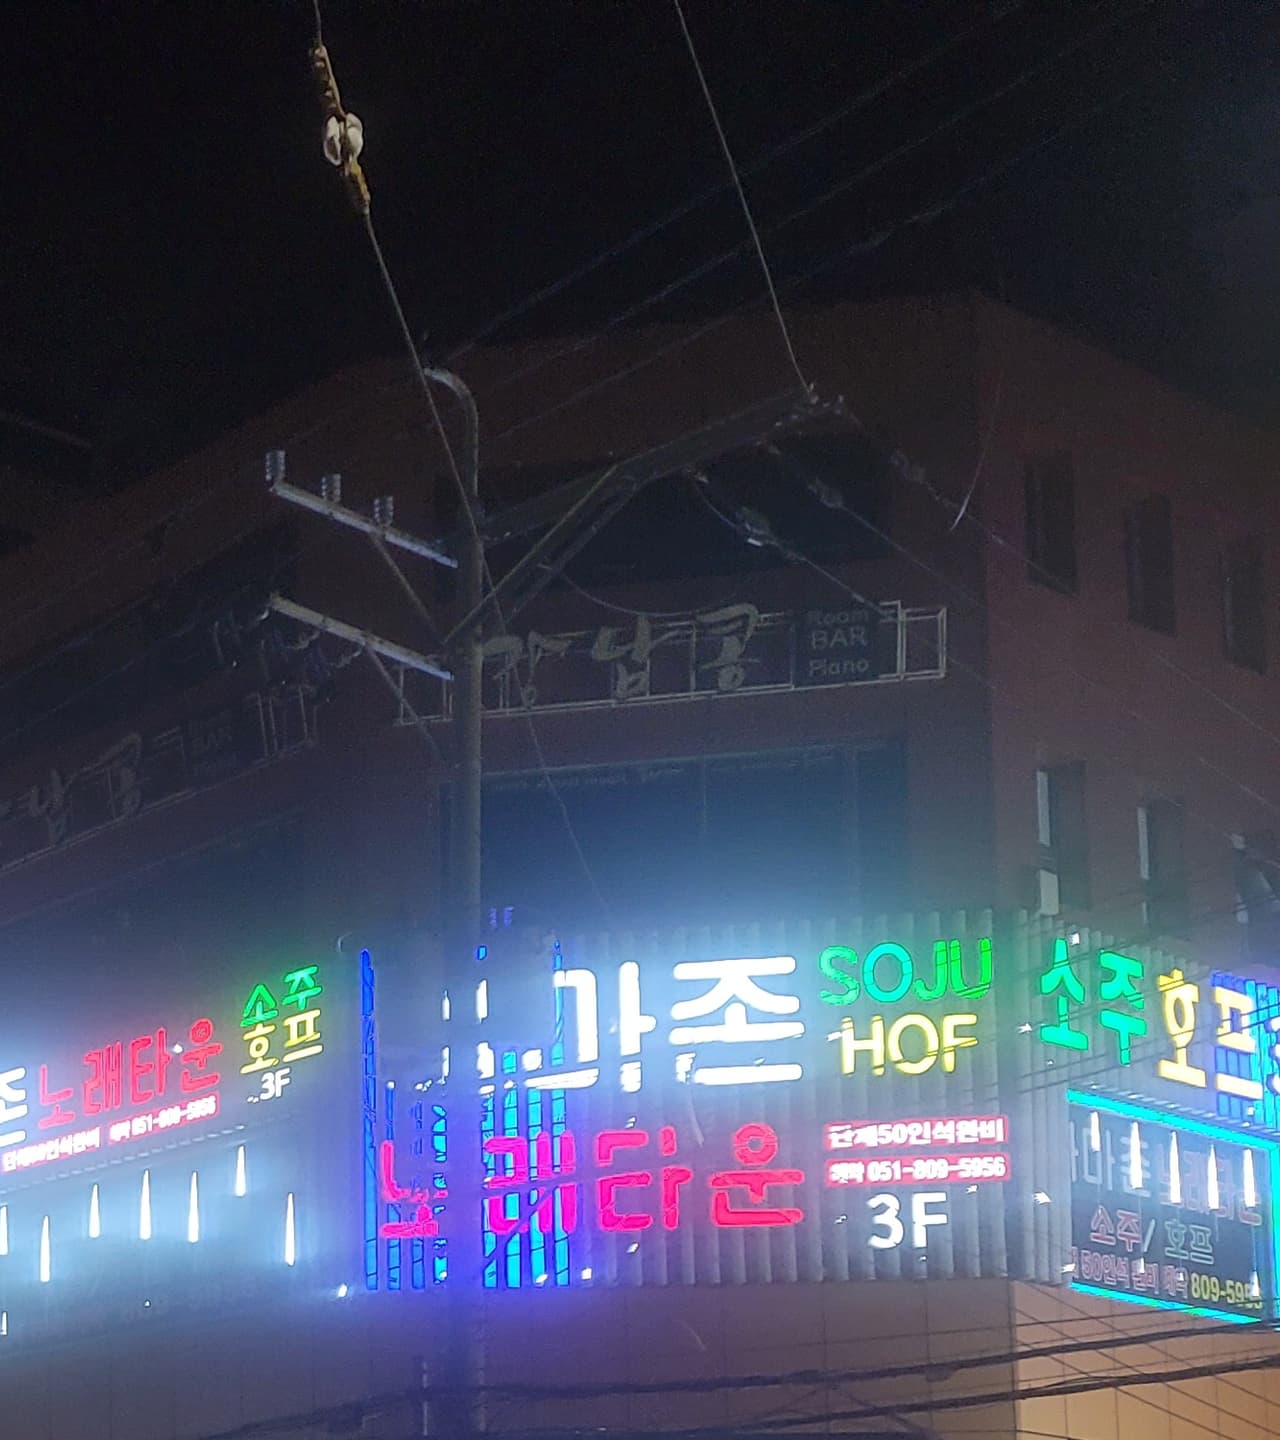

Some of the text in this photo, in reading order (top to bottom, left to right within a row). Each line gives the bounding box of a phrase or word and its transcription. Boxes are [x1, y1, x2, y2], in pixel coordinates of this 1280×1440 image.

[808, 656, 870, 678] Piano
[810, 627, 870, 651] BAR
[239, 964, 323, 1029] 소주
[817, 936, 993, 1006] SOJU
[239, 1007, 324, 1075] 호프
[840, 1013, 979, 1076] HOF
[1039, 936, 1265, 1100] 소주 호프
[36, 1016, 223, 1129] 노래타운
[259, 1066, 293, 1102] 3F
[866, 1191, 949, 1250] 3F
